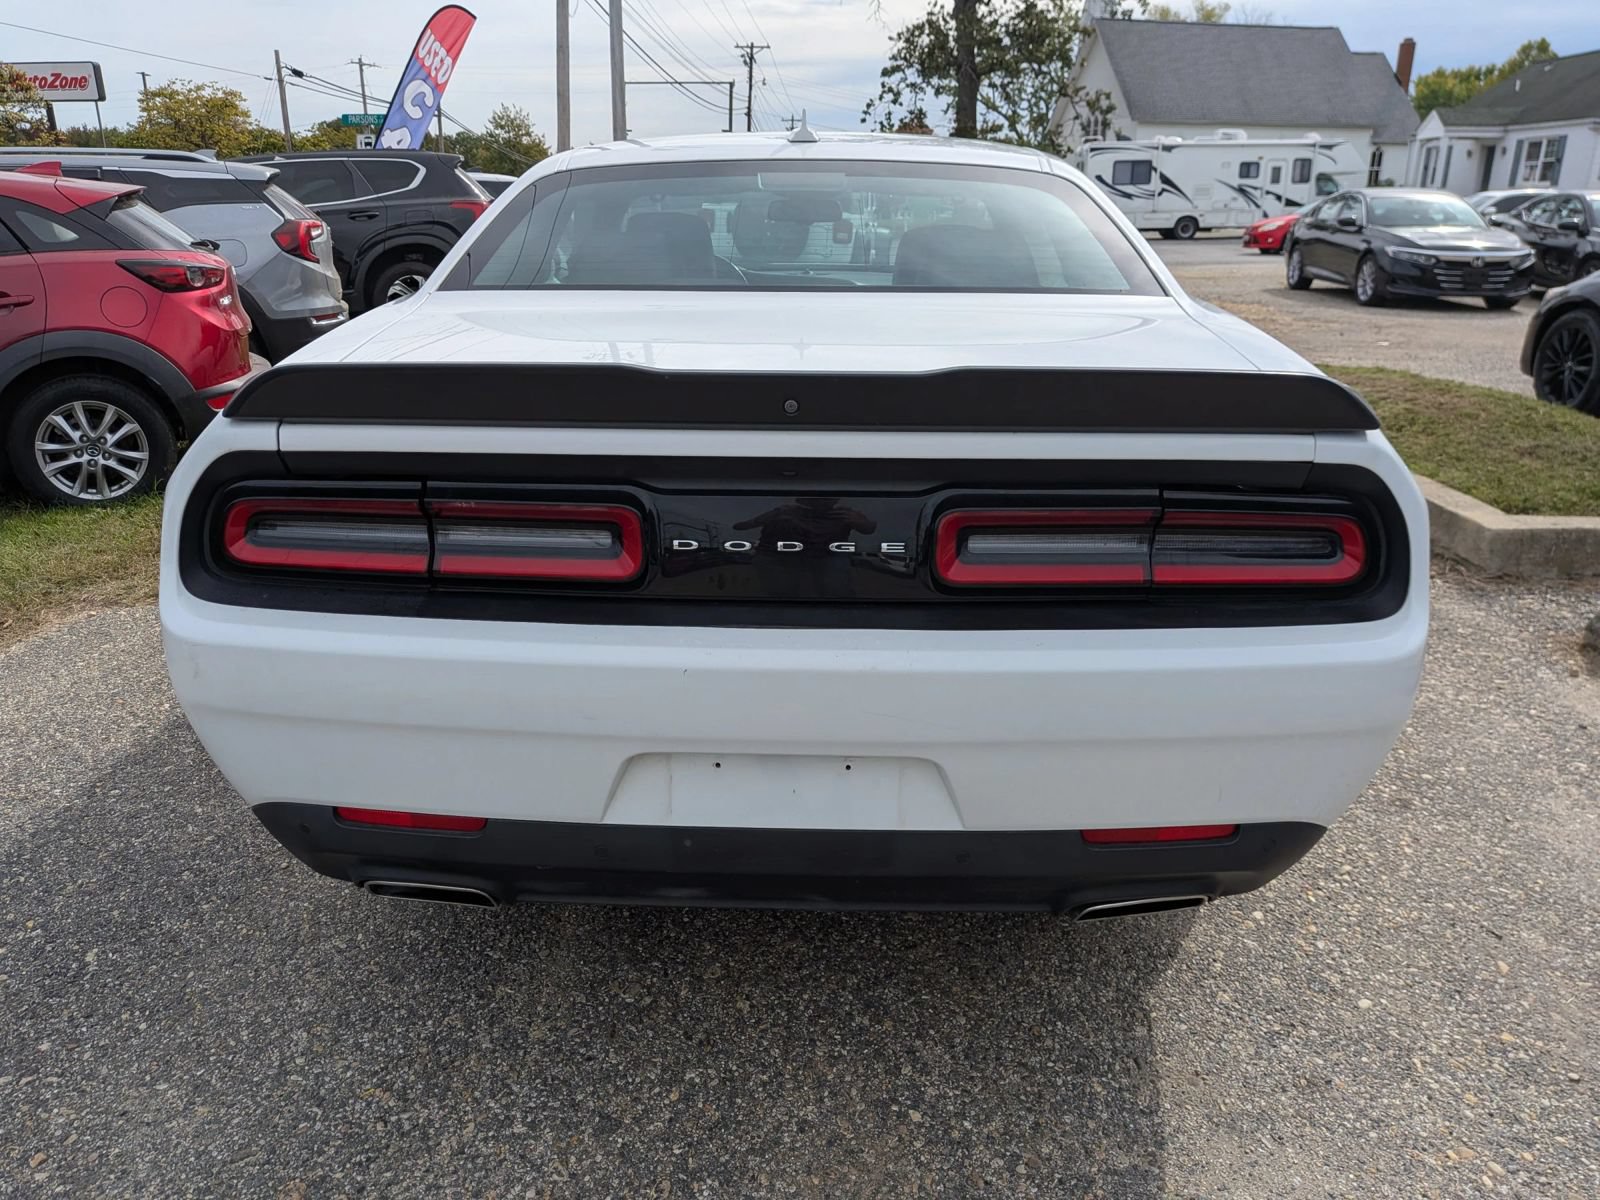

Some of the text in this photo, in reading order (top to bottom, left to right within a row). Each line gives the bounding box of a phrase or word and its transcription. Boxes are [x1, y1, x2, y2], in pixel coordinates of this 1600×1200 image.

[418, 29, 452, 84] USED
[15, 72, 88, 90] utoZone
[348, 114, 377, 124] PARSONS
[672, 538, 906, 553] DODGE
